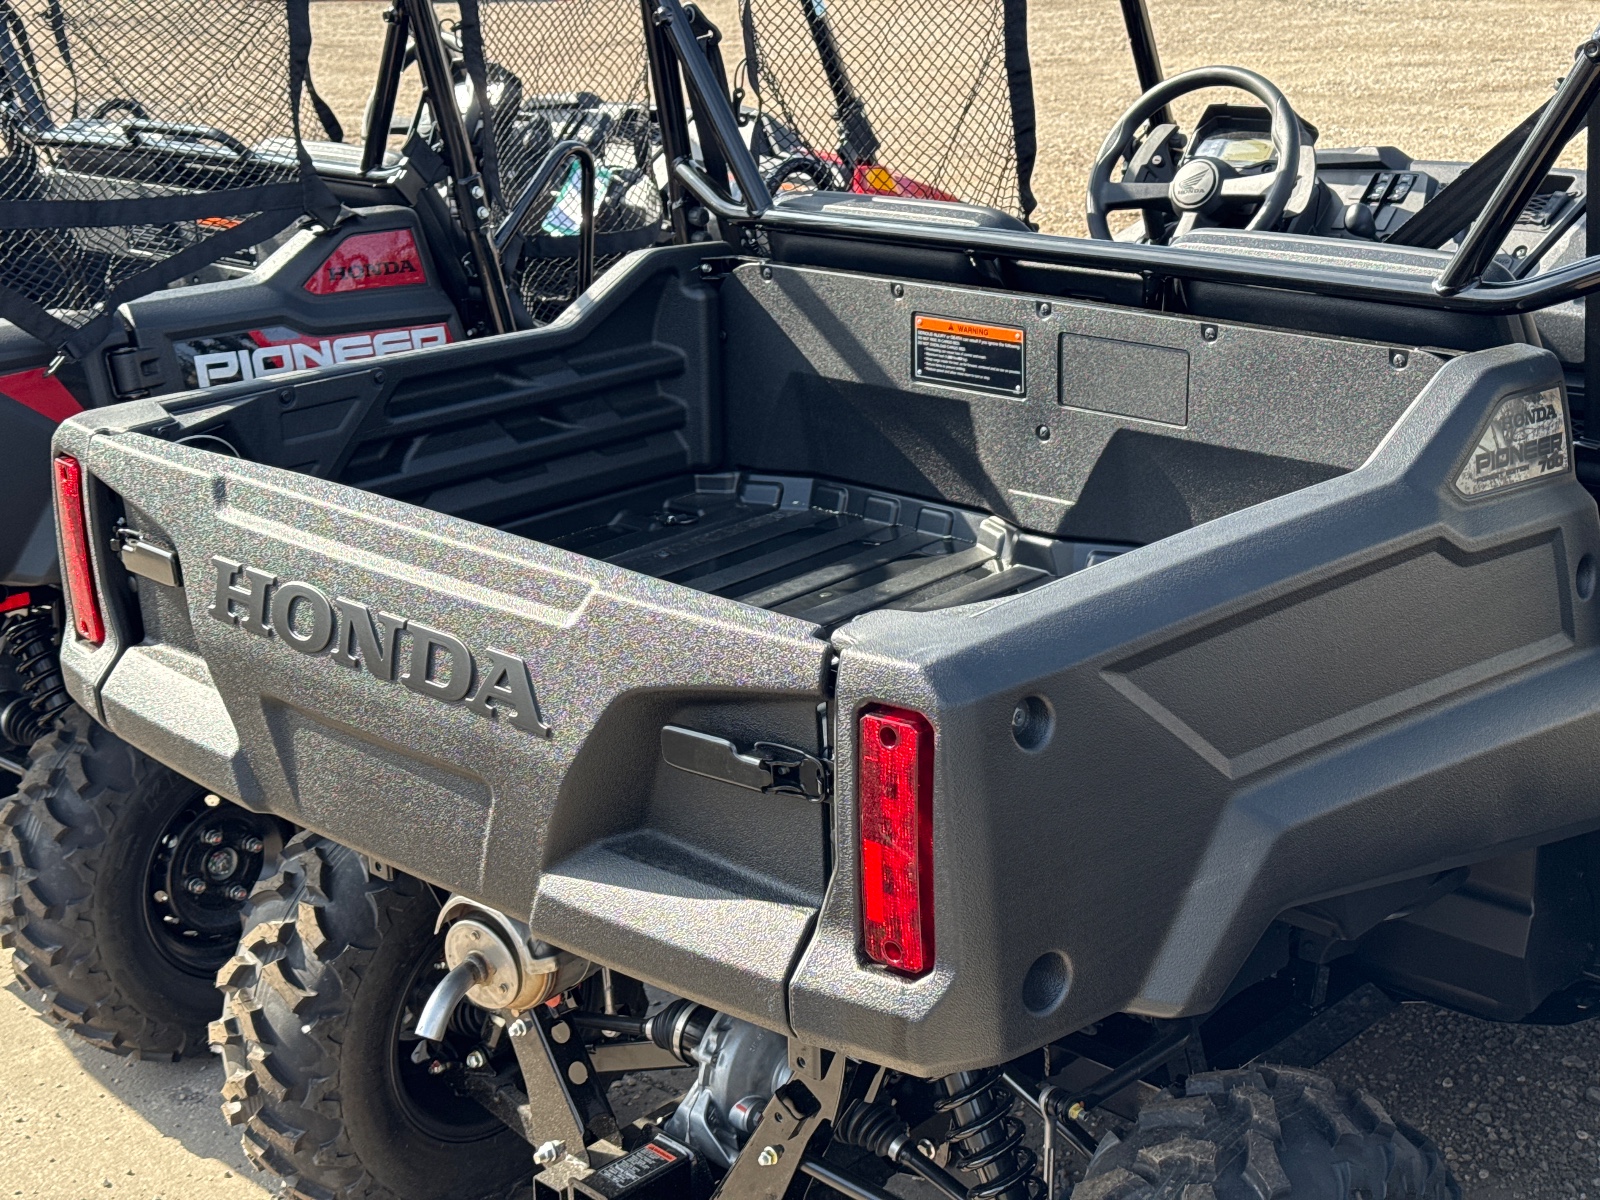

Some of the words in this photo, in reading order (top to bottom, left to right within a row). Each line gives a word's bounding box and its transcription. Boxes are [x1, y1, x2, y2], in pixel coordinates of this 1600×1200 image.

[327, 260, 417, 281] HONDA
[958, 325, 988, 336] WARNING
[1501, 404, 1557, 430] HONDA
[1475, 432, 1562, 474] PIONEER
[207, 555, 551, 738] HONDA
